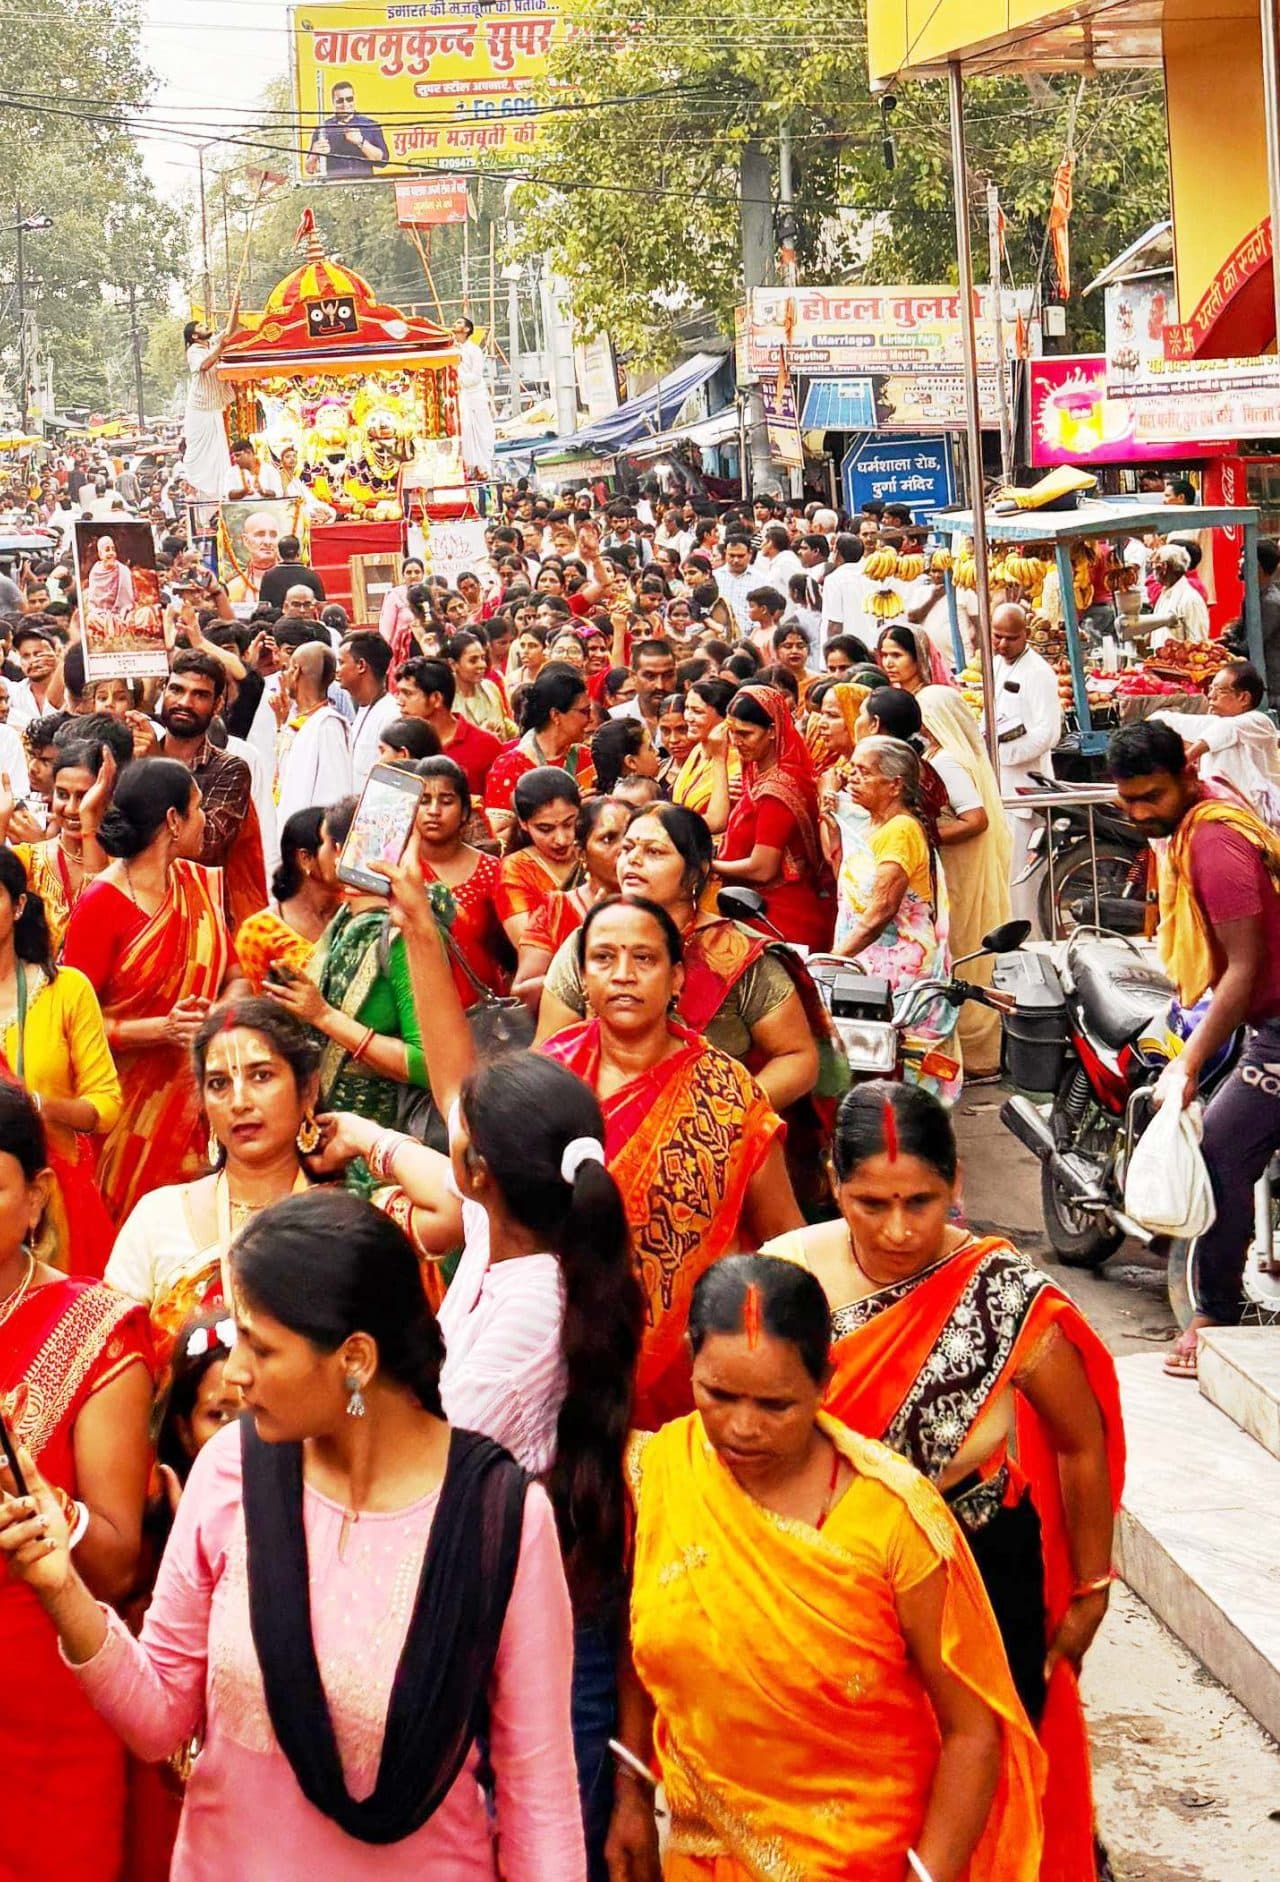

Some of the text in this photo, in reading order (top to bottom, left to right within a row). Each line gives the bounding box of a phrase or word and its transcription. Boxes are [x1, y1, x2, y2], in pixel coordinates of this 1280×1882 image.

[487, 19, 554, 70] सुपर
[1222, 262, 1239, 294] का
[799, 292, 882, 321] होटल
[856, 453, 941, 473] धर्मशाला रोड,
[872, 474, 935, 498] दुर्गा मंदिर
